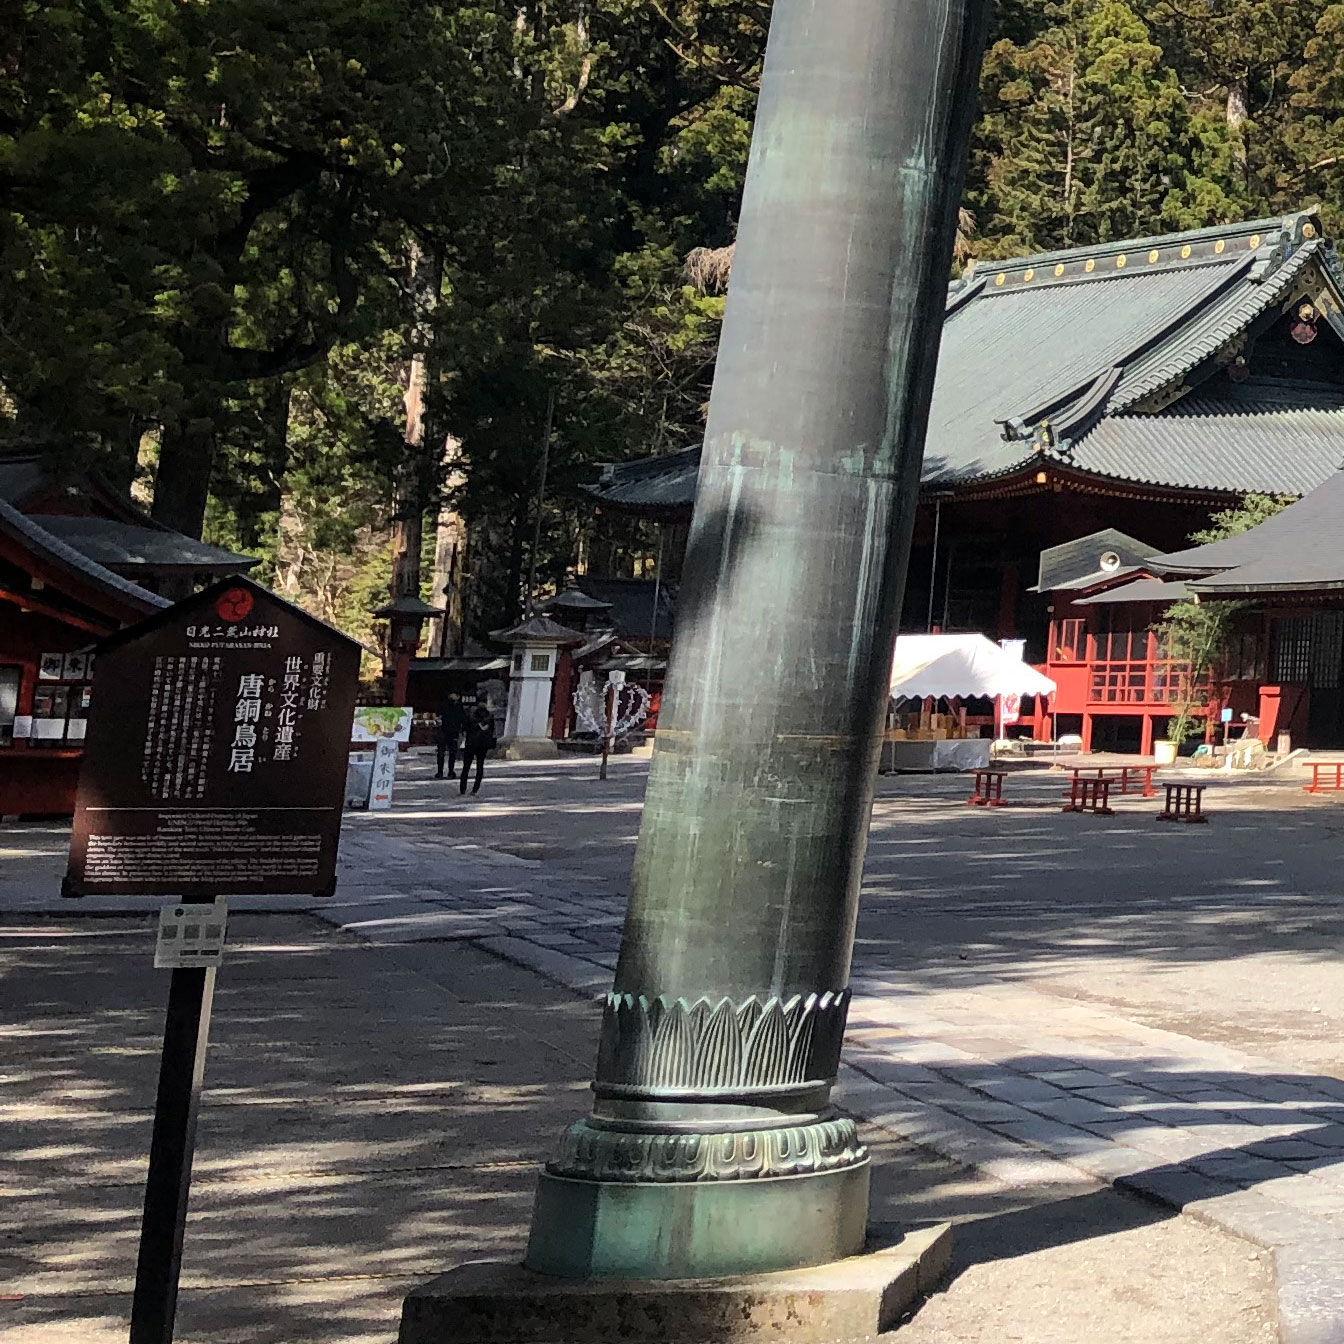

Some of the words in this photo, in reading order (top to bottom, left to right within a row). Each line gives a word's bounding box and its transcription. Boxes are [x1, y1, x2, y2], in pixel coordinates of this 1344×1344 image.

[186, 625, 279, 638] 日光二荒山神社
[273, 656, 303, 761] 世界文化遺産
[307, 652, 325, 710] 重要文化財
[227, 673, 265, 773] 唐銅鳥居
